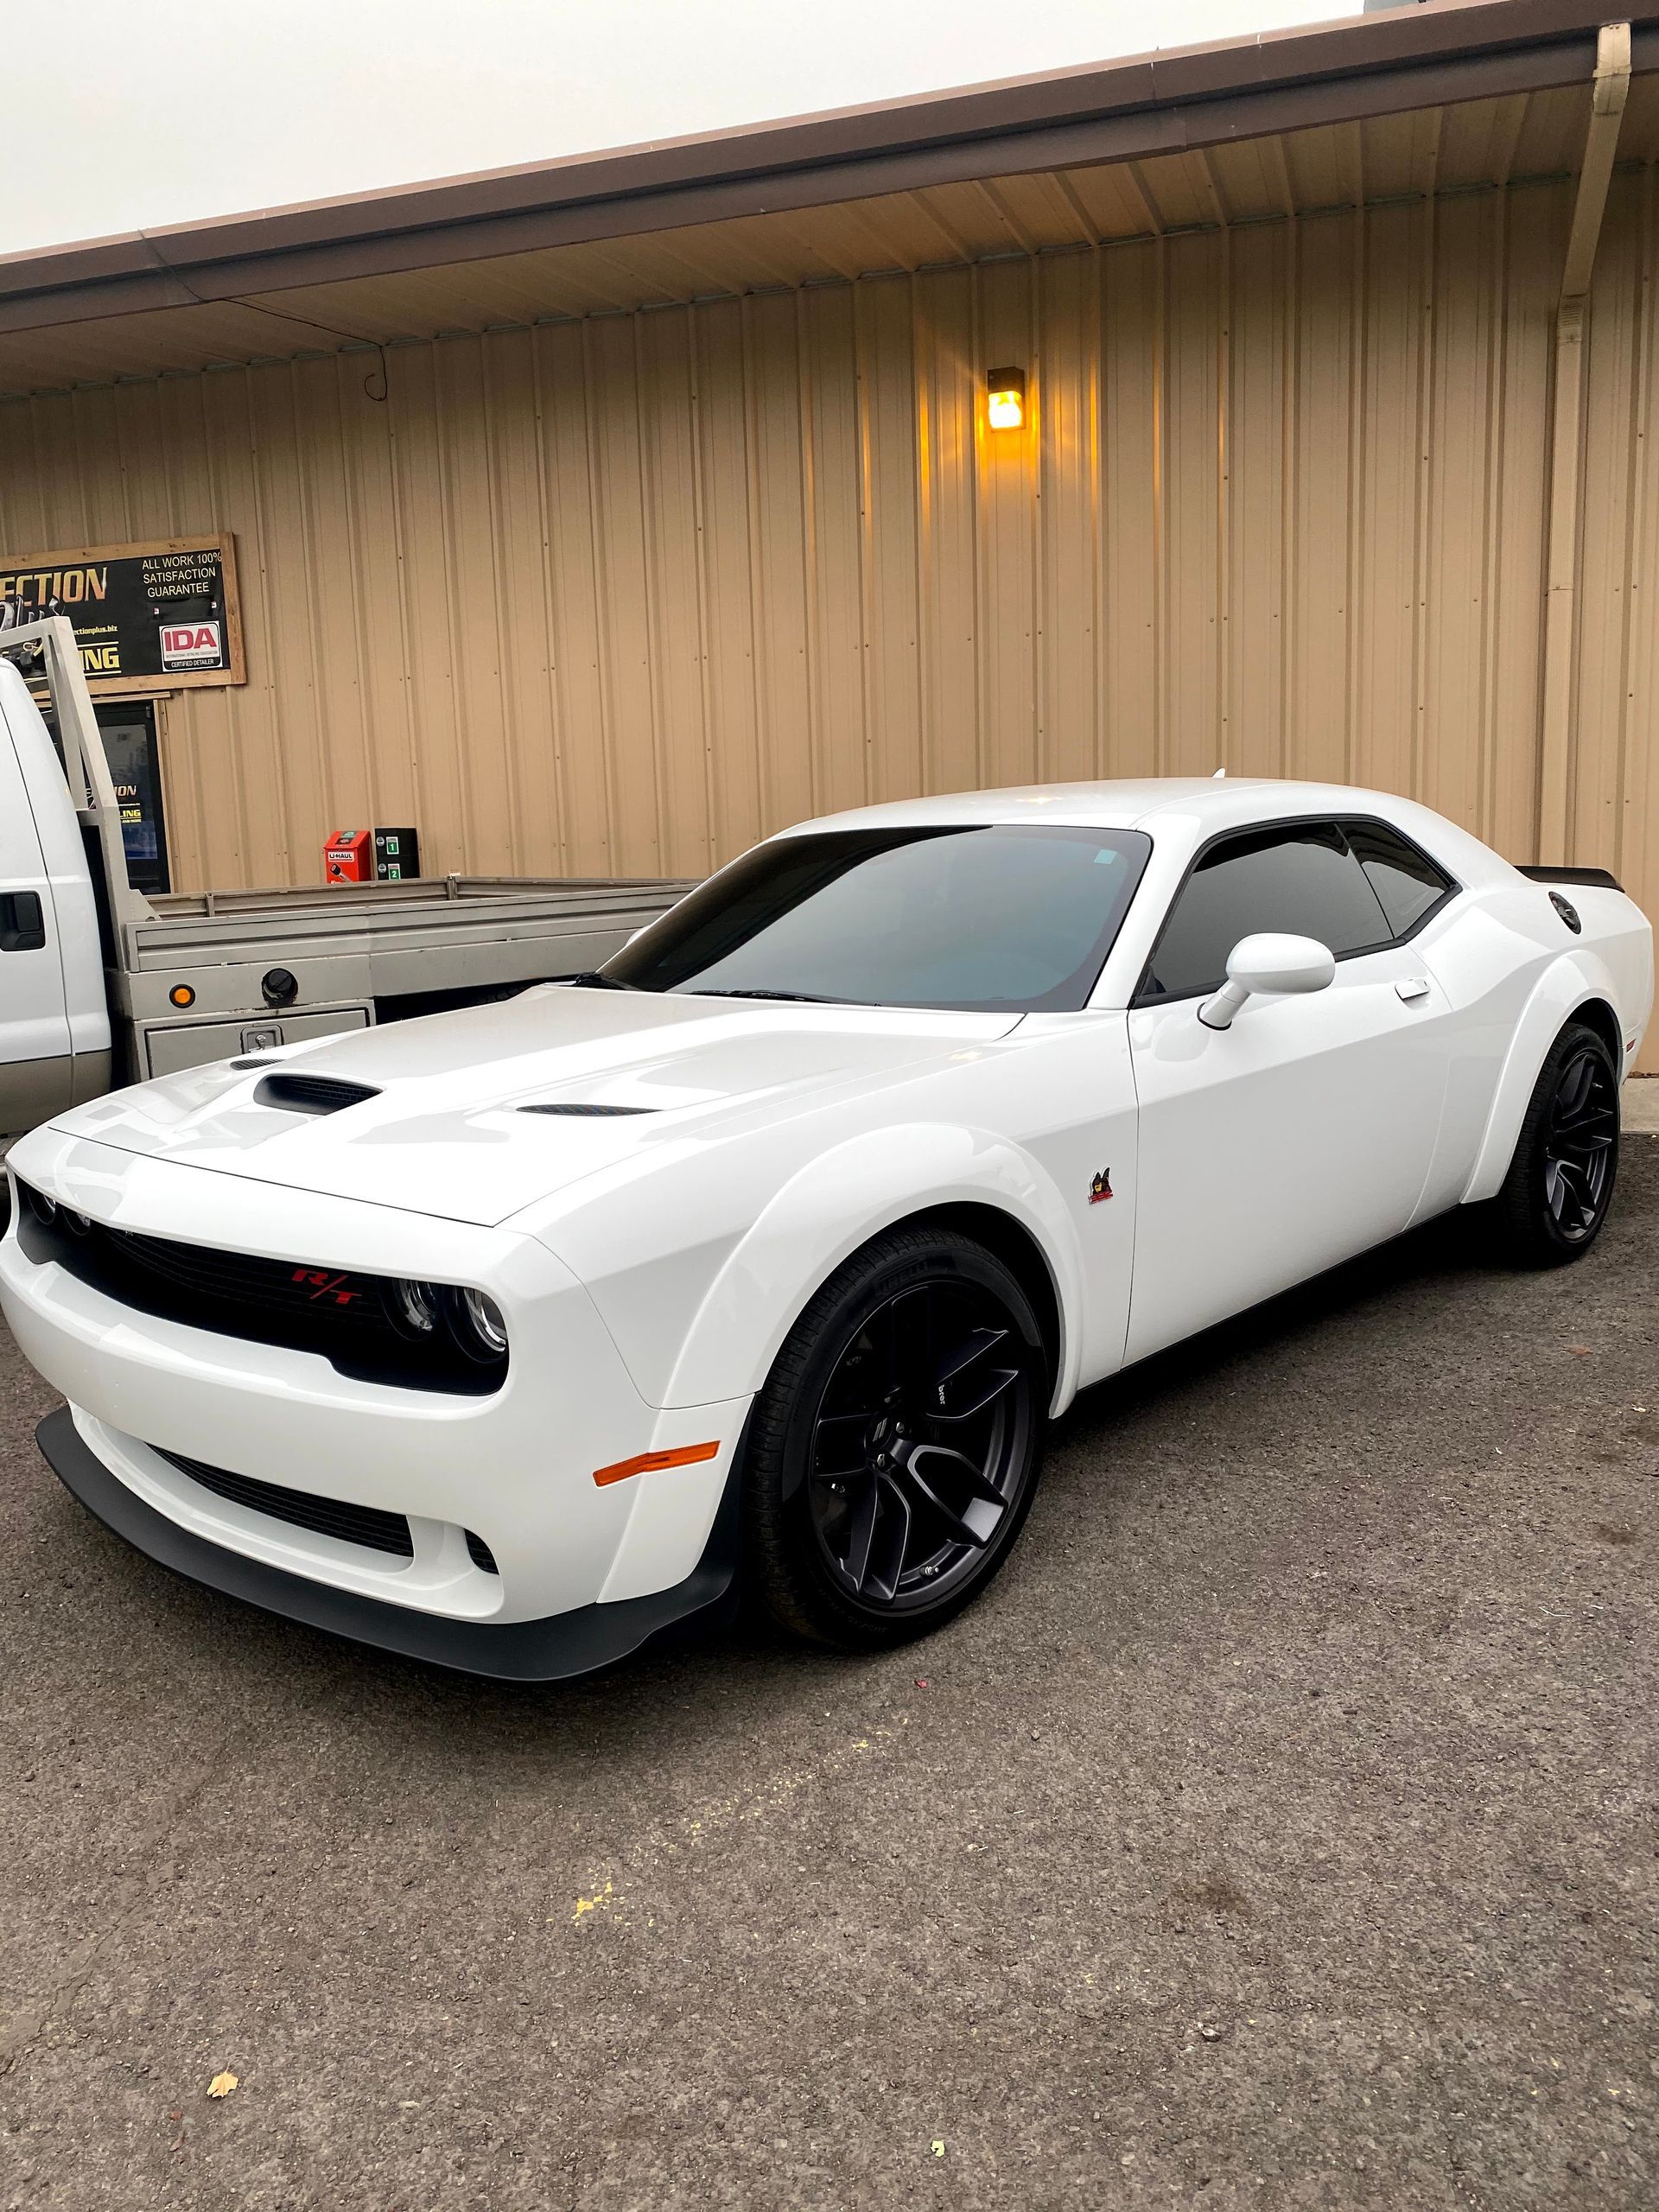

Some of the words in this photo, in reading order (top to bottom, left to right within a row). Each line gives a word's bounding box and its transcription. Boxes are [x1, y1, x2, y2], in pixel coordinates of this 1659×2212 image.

[142, 559, 160, 570] ALL
[162, 555, 194, 568] WORK
[197, 551, 222, 564] 100%
[143, 567, 216, 584] SATISFACTION
[147, 582, 210, 598] GUARANTEE
[164, 628, 217, 652] IDA
[292, 1269, 362, 1304] R/T
